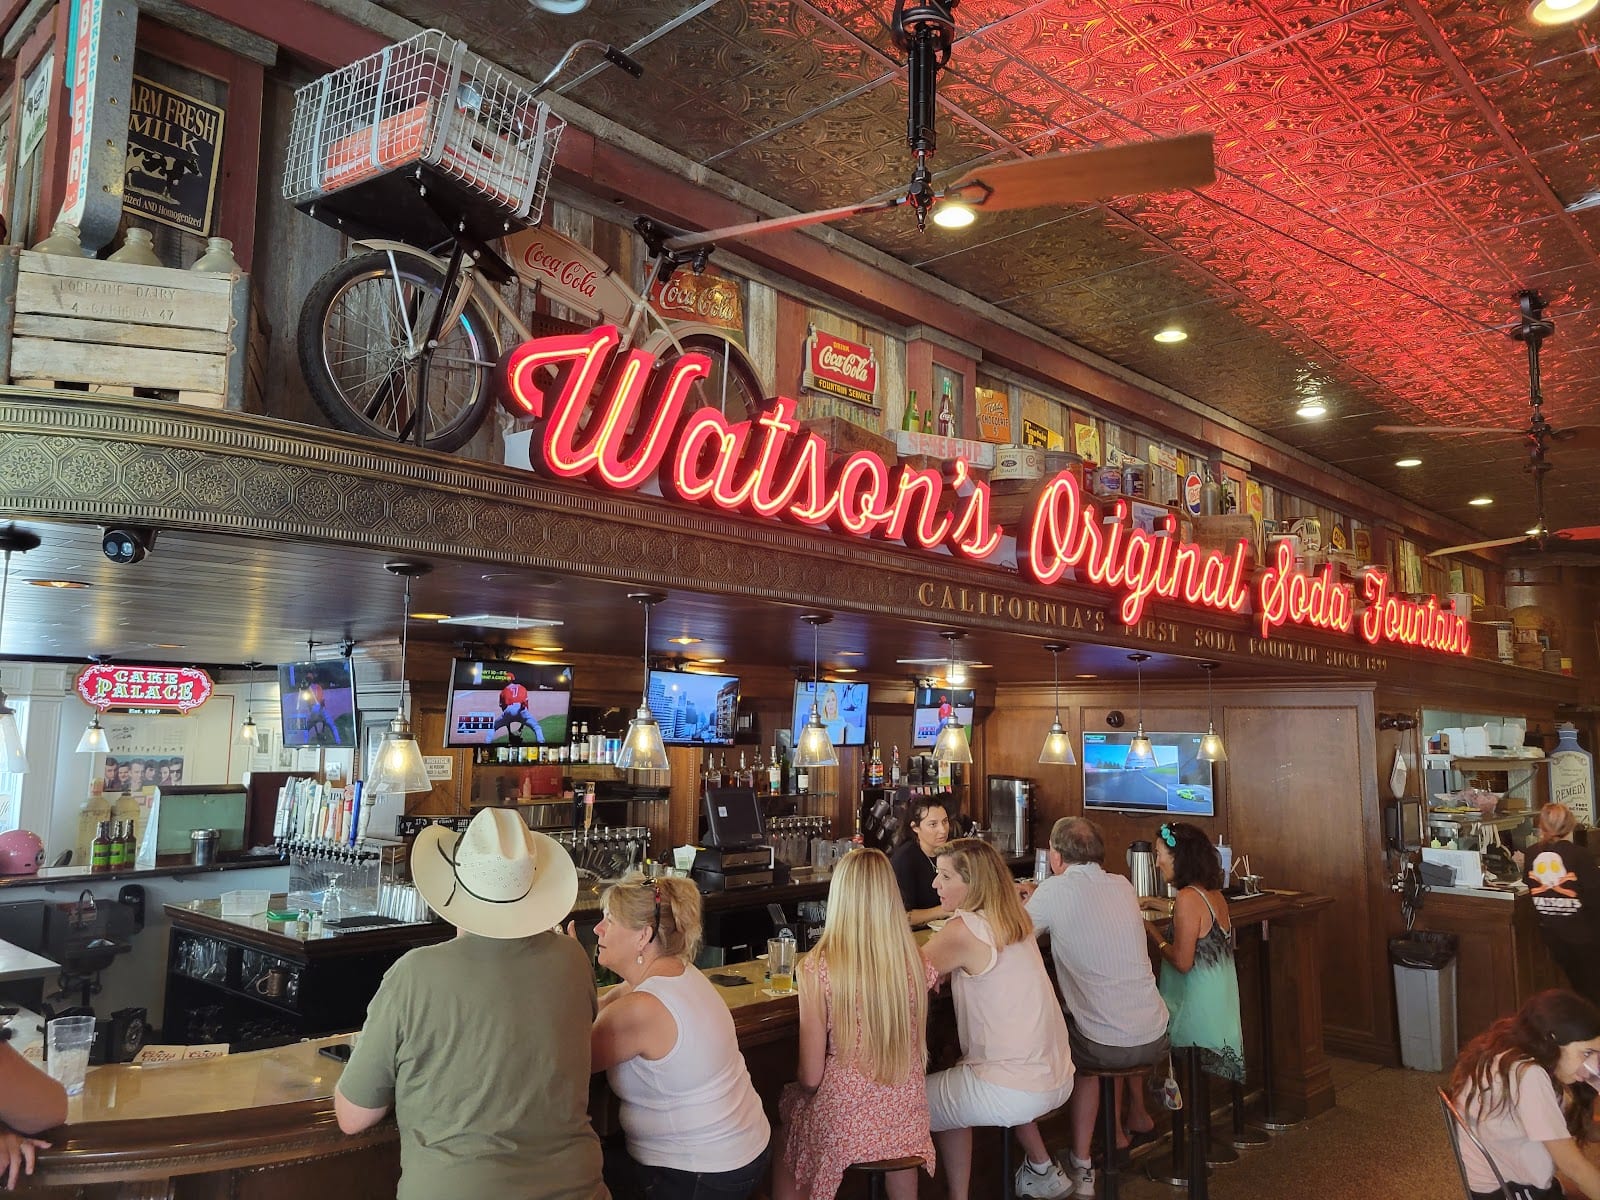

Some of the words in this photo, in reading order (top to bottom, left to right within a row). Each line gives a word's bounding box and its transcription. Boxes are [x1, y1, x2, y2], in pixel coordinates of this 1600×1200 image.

[131, 83, 162, 117] ARM
[165, 96, 216, 145] FRESH
[129, 114, 201, 156] MILK
[142, 199, 158, 212] AND
[158, 203, 202, 227] Homogenized
[136, 286, 176, 300] DAIRY
[71, 302, 79, 313] 4
[159, 309, 174, 321] 47
[833, 341, 850, 352] DRINK
[819, 379, 848, 395] FOUNTAIN
[848, 390, 871, 402] SERVICE
[981, 414, 1009, 427] CHOCOLATE
[506, 325, 1003, 559] Watson's
[1029, 469, 1248, 626] Original
[1261, 538, 1351, 638] Soda
[1363, 567, 1471, 656] Fountain
[918, 582, 1105, 632] CALIFORNIA'S
[1124, 620, 1179, 643] FIRST
[1195, 629, 1236, 652] SODA
[1250, 637, 1317, 663] FOUNTAIN
[1325, 650, 1361, 669] SINCE
[1365, 656, 1388, 670] 1899
[96, 677, 194, 700] PALACE
[113, 670, 179, 685] CAKE
[511, 687, 518, 698] 7
[1556, 776, 1587, 804] REMEDY
